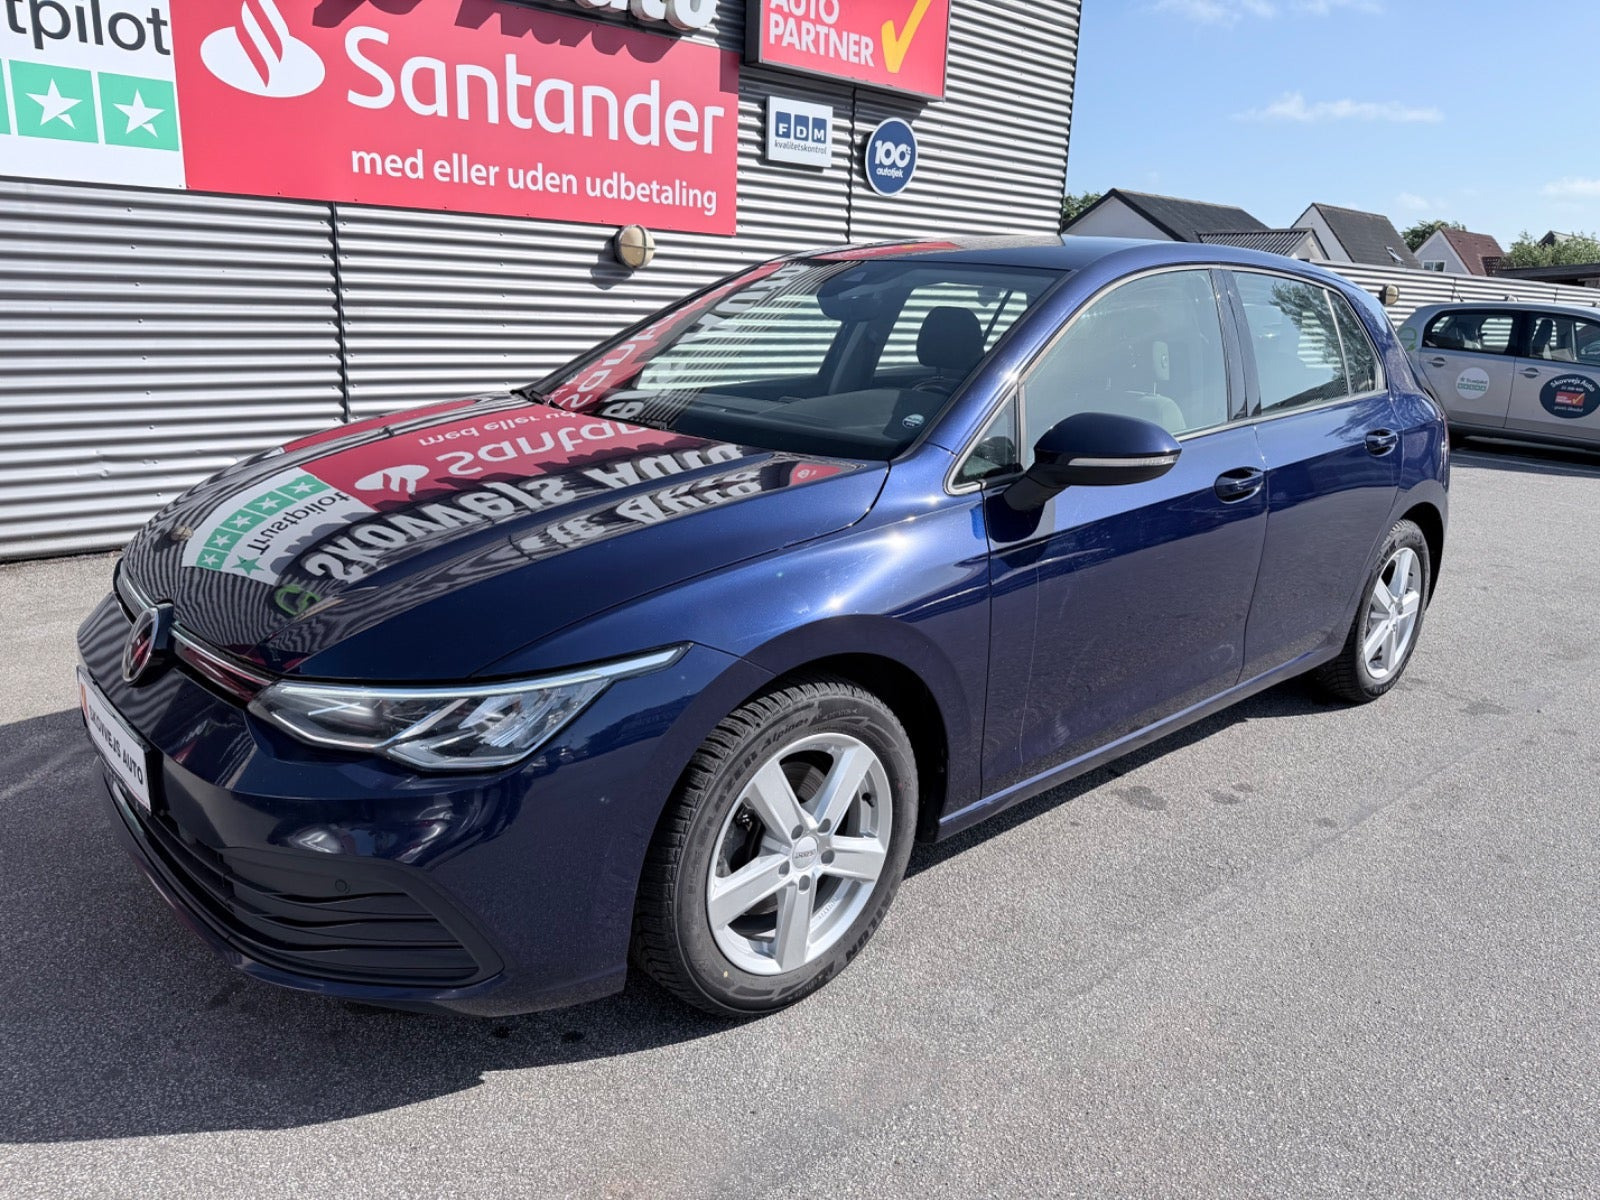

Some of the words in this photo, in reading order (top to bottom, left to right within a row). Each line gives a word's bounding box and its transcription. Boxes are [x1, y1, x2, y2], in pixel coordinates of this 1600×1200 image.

[769, 12, 875, 67] PARTNER
[344, 25, 724, 154] Santander
[774, 139, 827, 155] kvalitetskontrol
[777, 121, 825, 142] FDM
[351, 148, 424, 180] med
[433, 153, 500, 187] eller
[507, 162, 578, 195] uden
[586, 172, 718, 217] udbetaling
[122, 749, 144, 785] AUTO
